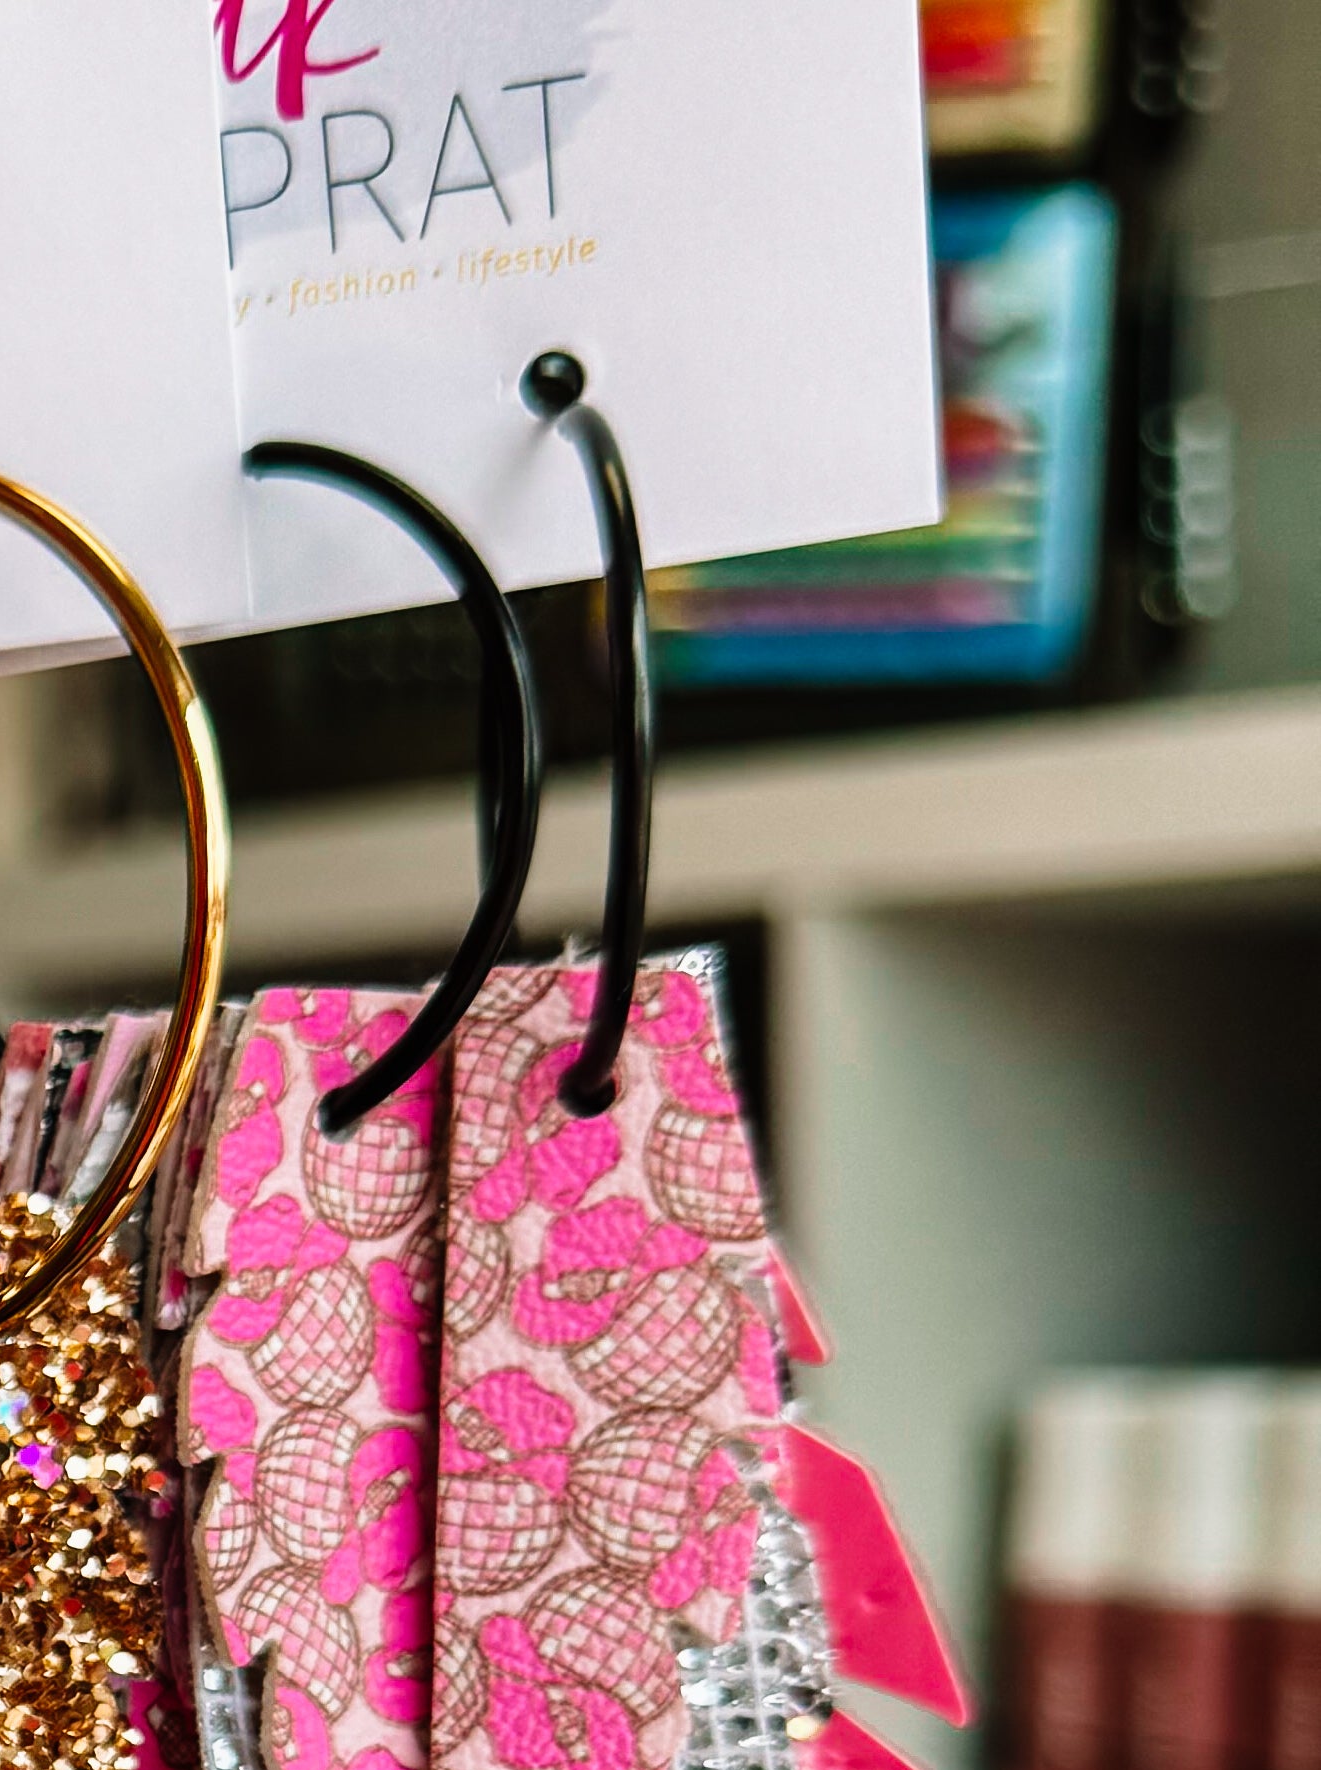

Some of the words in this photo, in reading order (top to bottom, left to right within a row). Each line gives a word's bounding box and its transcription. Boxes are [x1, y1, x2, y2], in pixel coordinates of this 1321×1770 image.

[220, 72, 588, 271] PRAT
[286, 264, 420, 317] fashion
[455, 233, 598, 286] lifestyle
